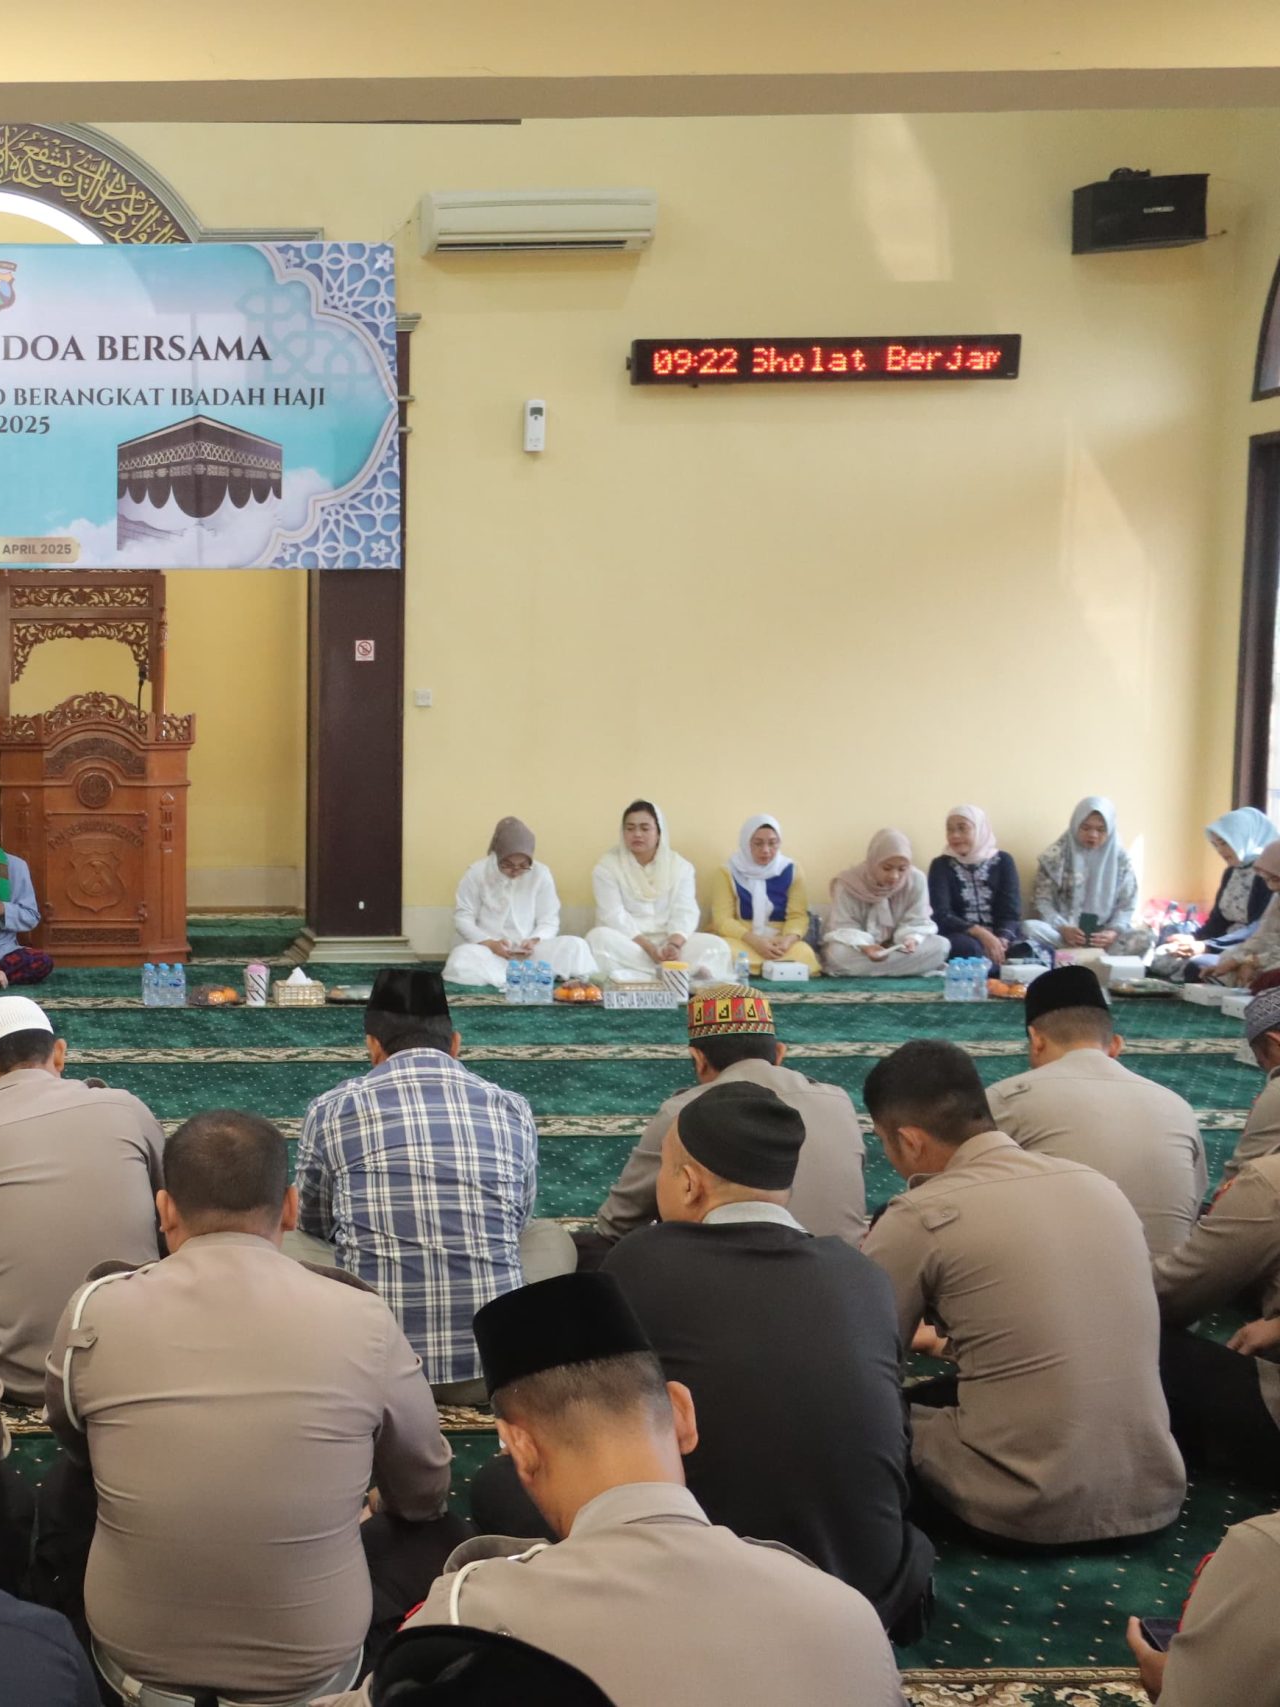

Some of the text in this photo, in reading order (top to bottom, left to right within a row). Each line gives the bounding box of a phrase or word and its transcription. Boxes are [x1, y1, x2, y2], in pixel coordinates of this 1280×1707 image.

[2, 335, 86, 361] DOA
[97, 335, 273, 361] BERSAMA
[652, 347, 739, 375] 09:22
[14, 387, 165, 406] BERANGKAT
[172, 387, 266, 406] IBADAH
[273, 387, 326, 410] HAJI
[2, 544, 37, 555] APRIL
[41, 543, 72, 555] 2025
